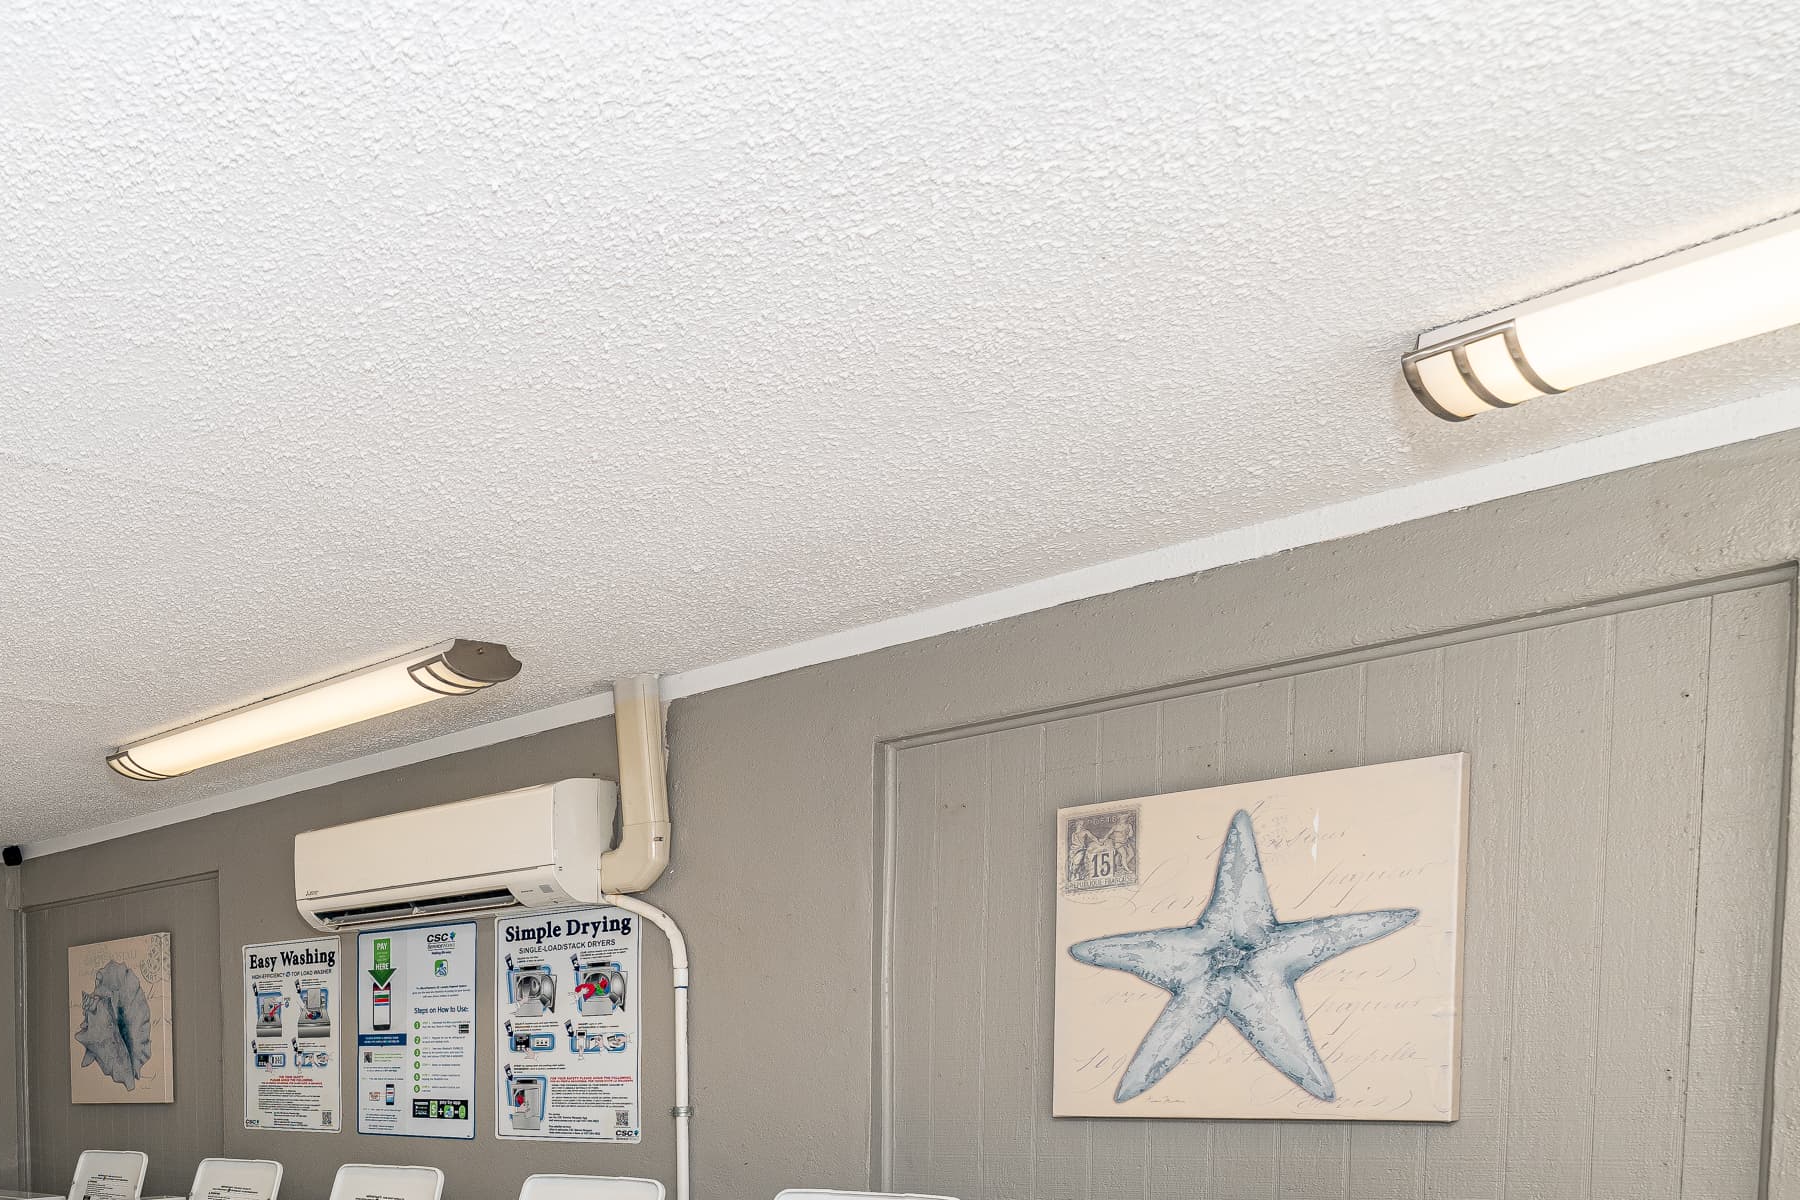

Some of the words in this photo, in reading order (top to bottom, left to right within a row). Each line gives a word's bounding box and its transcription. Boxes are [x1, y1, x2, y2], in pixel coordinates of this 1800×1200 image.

[1091, 853, 1111, 878] 15
[505, 921, 561, 944] Simple
[566, 915, 632, 939] Drying
[426, 933, 449, 943] CSC
[376, 942, 387, 950] PAY
[519, 942, 586, 954] SINGLE-LOAD/STACK
[587, 939, 616, 948] DRYERS
[249, 954, 278, 972] Easy
[280, 948, 336, 968] Washing
[413, 1007, 429, 1015] Steps
